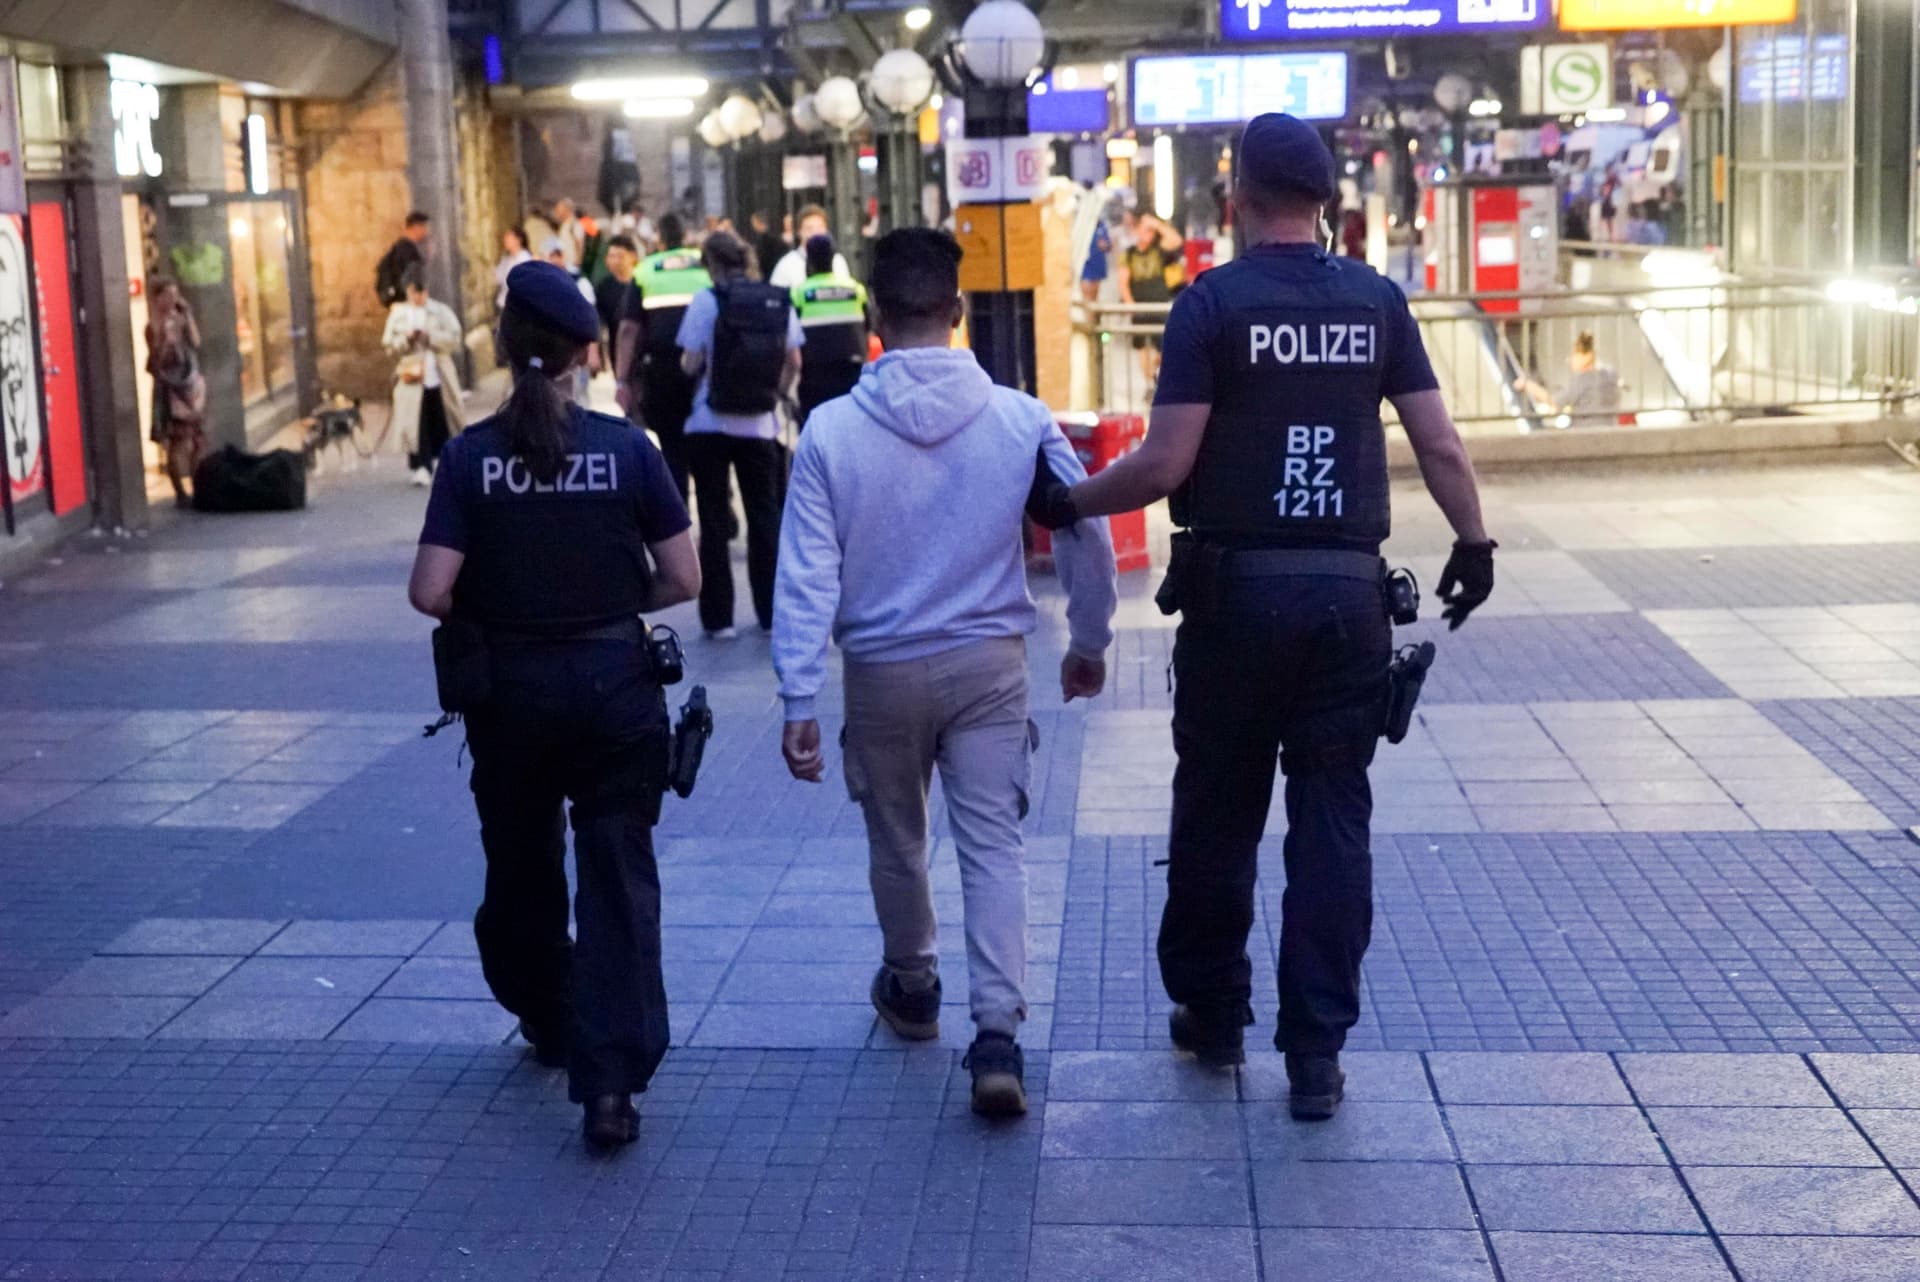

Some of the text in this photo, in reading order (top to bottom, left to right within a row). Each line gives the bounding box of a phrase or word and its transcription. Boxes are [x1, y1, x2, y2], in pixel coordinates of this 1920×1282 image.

[1250, 323, 1376, 364] POLIZEI
[1287, 425, 1335, 455] BP
[1284, 457, 1335, 486] RZ
[1273, 488, 1343, 517] 1211
